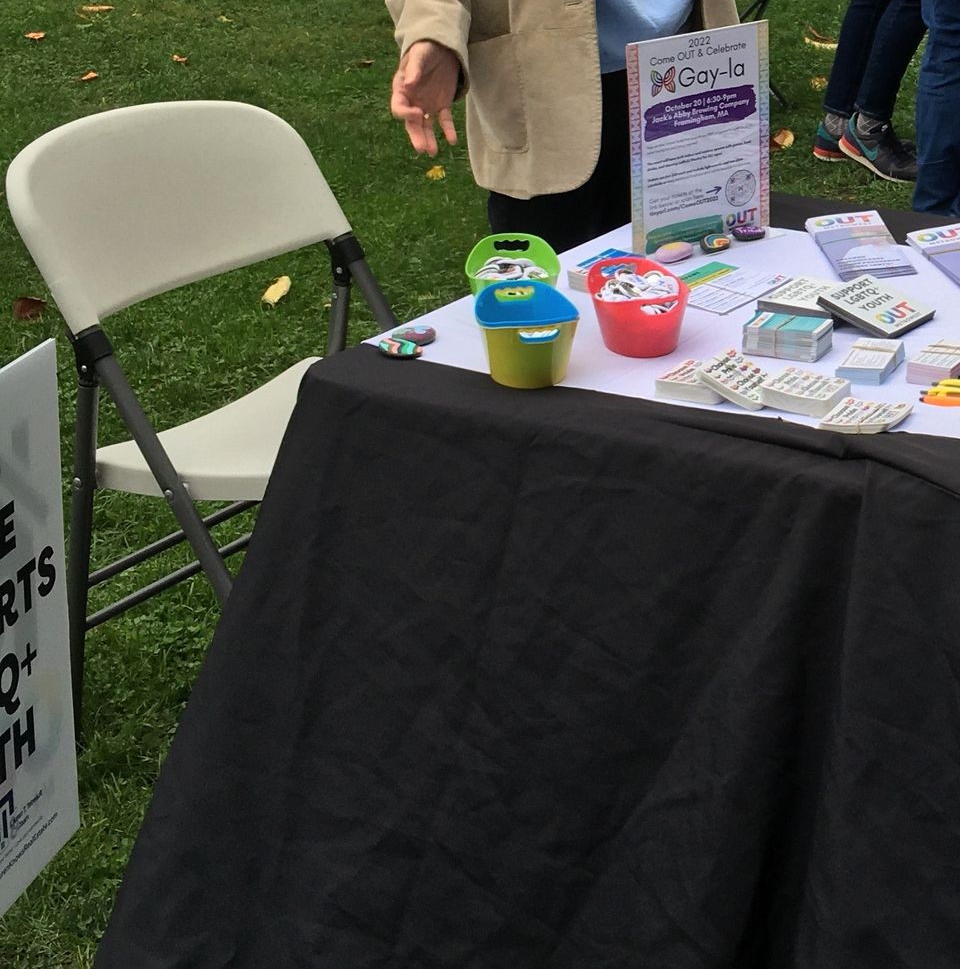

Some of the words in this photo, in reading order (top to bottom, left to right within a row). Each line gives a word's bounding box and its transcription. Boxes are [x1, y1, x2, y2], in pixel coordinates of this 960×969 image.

[688, 36, 711, 49] 2022
[650, 56, 675, 66] Come
[677, 50, 695, 61] OUT
[697, 48, 704, 57] &
[706, 41, 747, 56] Celebrate
[678, 57, 745, 89] Gay-la
[652, 114, 673, 124] Jack's
[673, 111, 691, 119] Abby
[692, 105, 718, 115] Brewing
[719, 99, 750, 110] Company
[665, 102, 692, 112] October
[706, 93, 737, 104] 6:30-9pm
[717, 110, 729, 118] MA
[726, 207, 757, 226] OUT
[815, 214, 873, 227] OUT
[831, 278, 873, 300] SUPPORT
[844, 287, 880, 305] LGBTQ+
[858, 293, 894, 311] YOUTH
[875, 301, 916, 324] OUT
